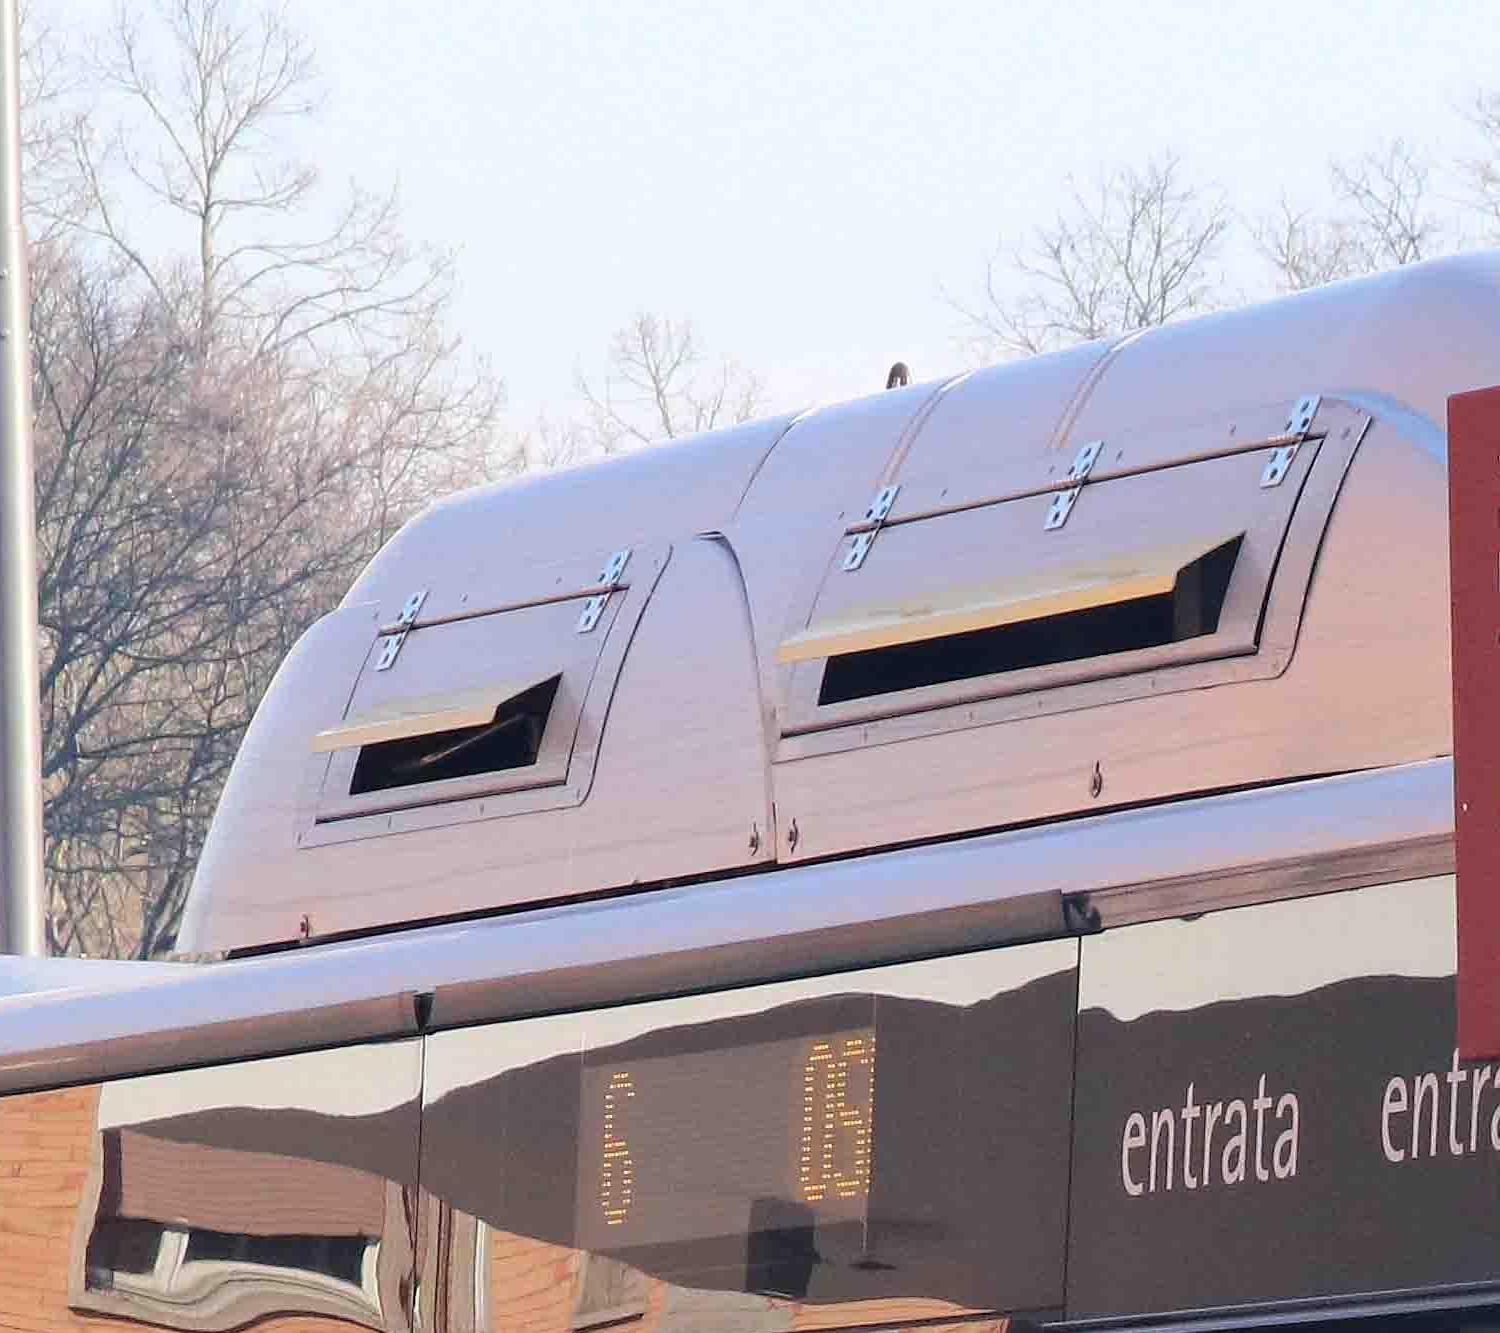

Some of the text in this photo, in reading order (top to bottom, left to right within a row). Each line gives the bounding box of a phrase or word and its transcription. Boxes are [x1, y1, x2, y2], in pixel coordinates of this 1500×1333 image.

[601, 1037, 876, 1225] 6 OS
[1120, 1072, 1300, 1197] entrata
